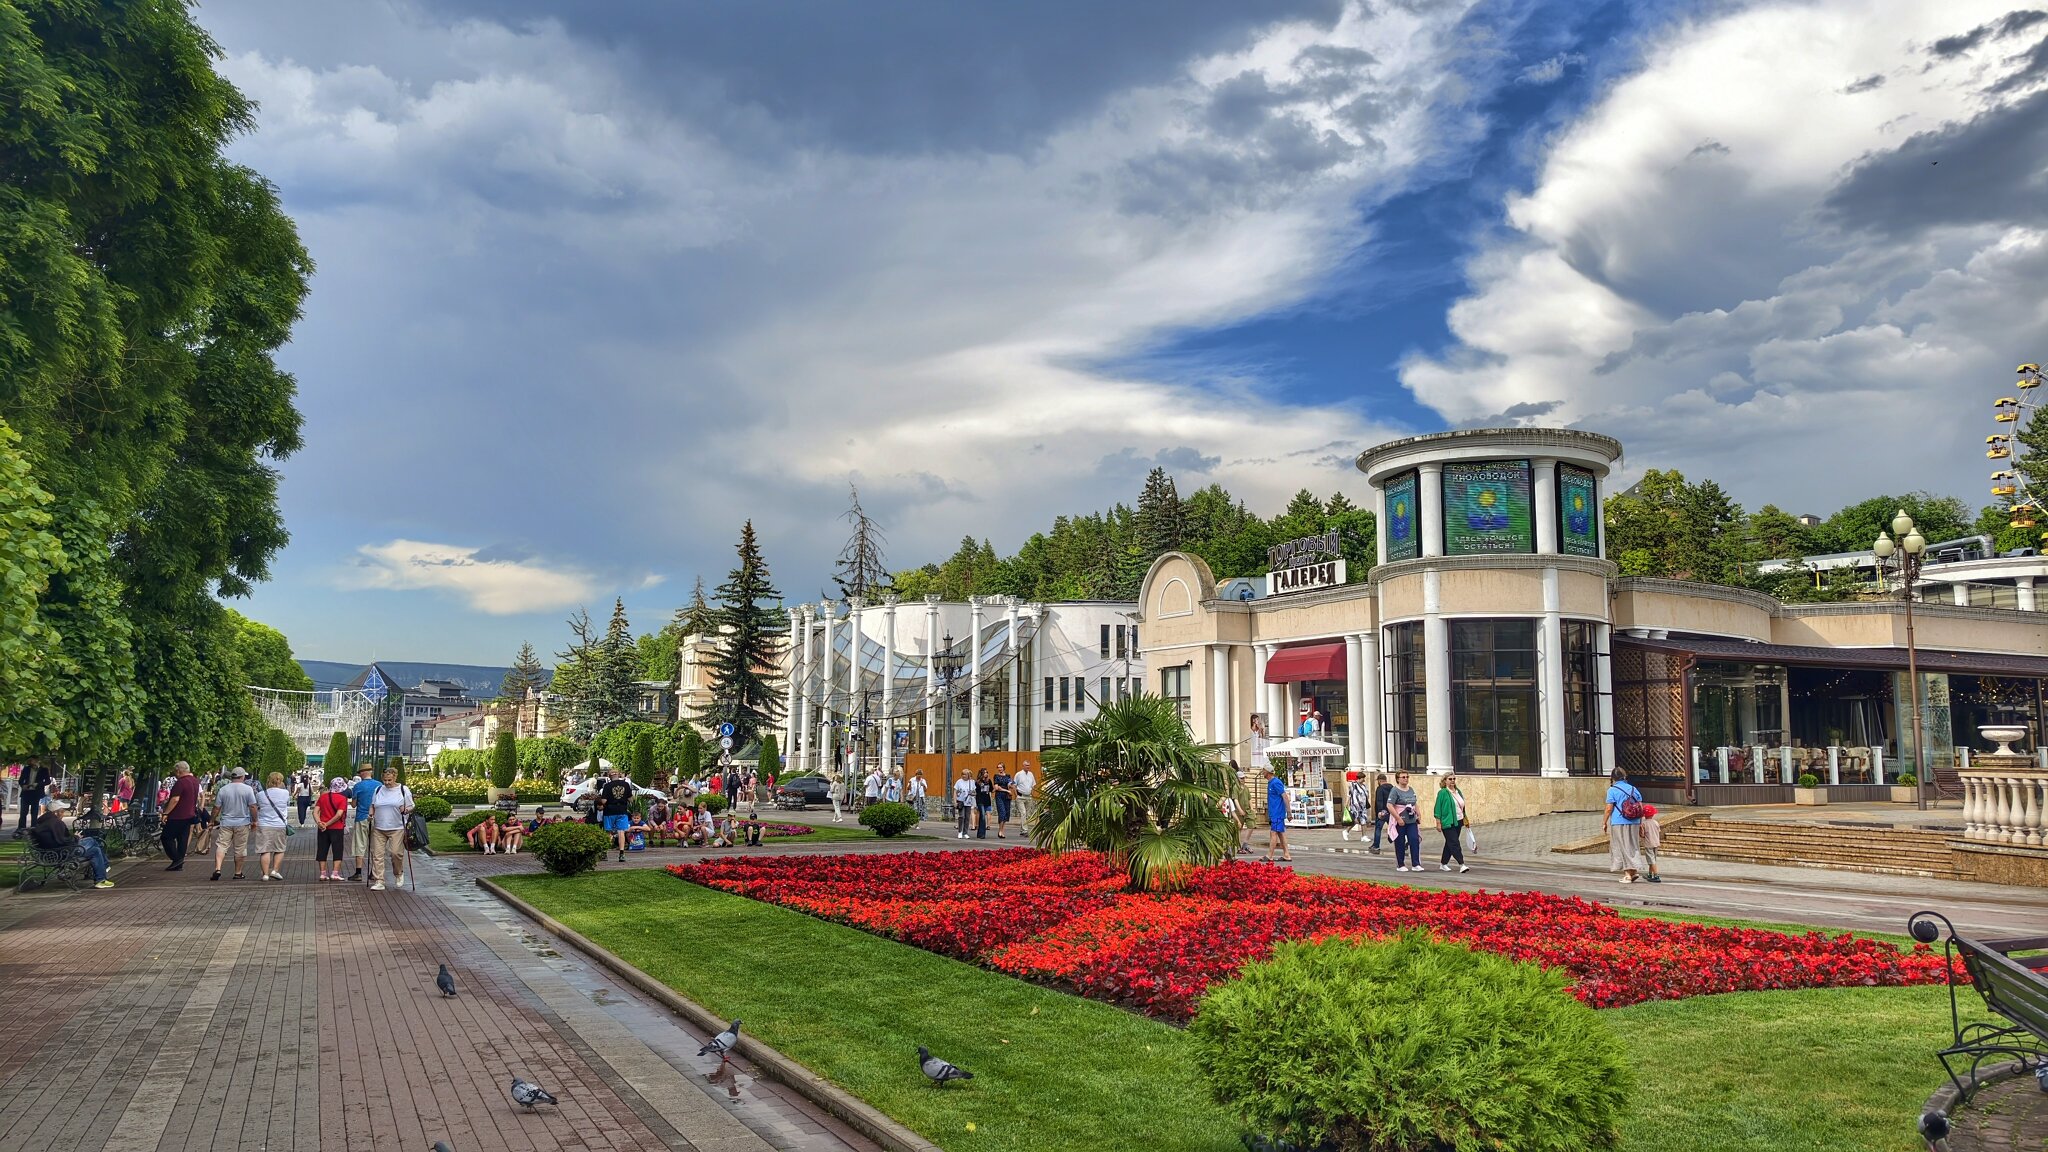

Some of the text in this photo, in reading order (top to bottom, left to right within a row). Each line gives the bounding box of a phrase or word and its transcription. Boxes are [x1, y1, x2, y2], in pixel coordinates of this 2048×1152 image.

[1267, 527, 1341, 571] ТОРГОВЫЙ
[1272, 562, 1337, 594] ГАЛЕРЕЯ
[1300, 747, 1341, 756] ЭКСКУРСИИ
